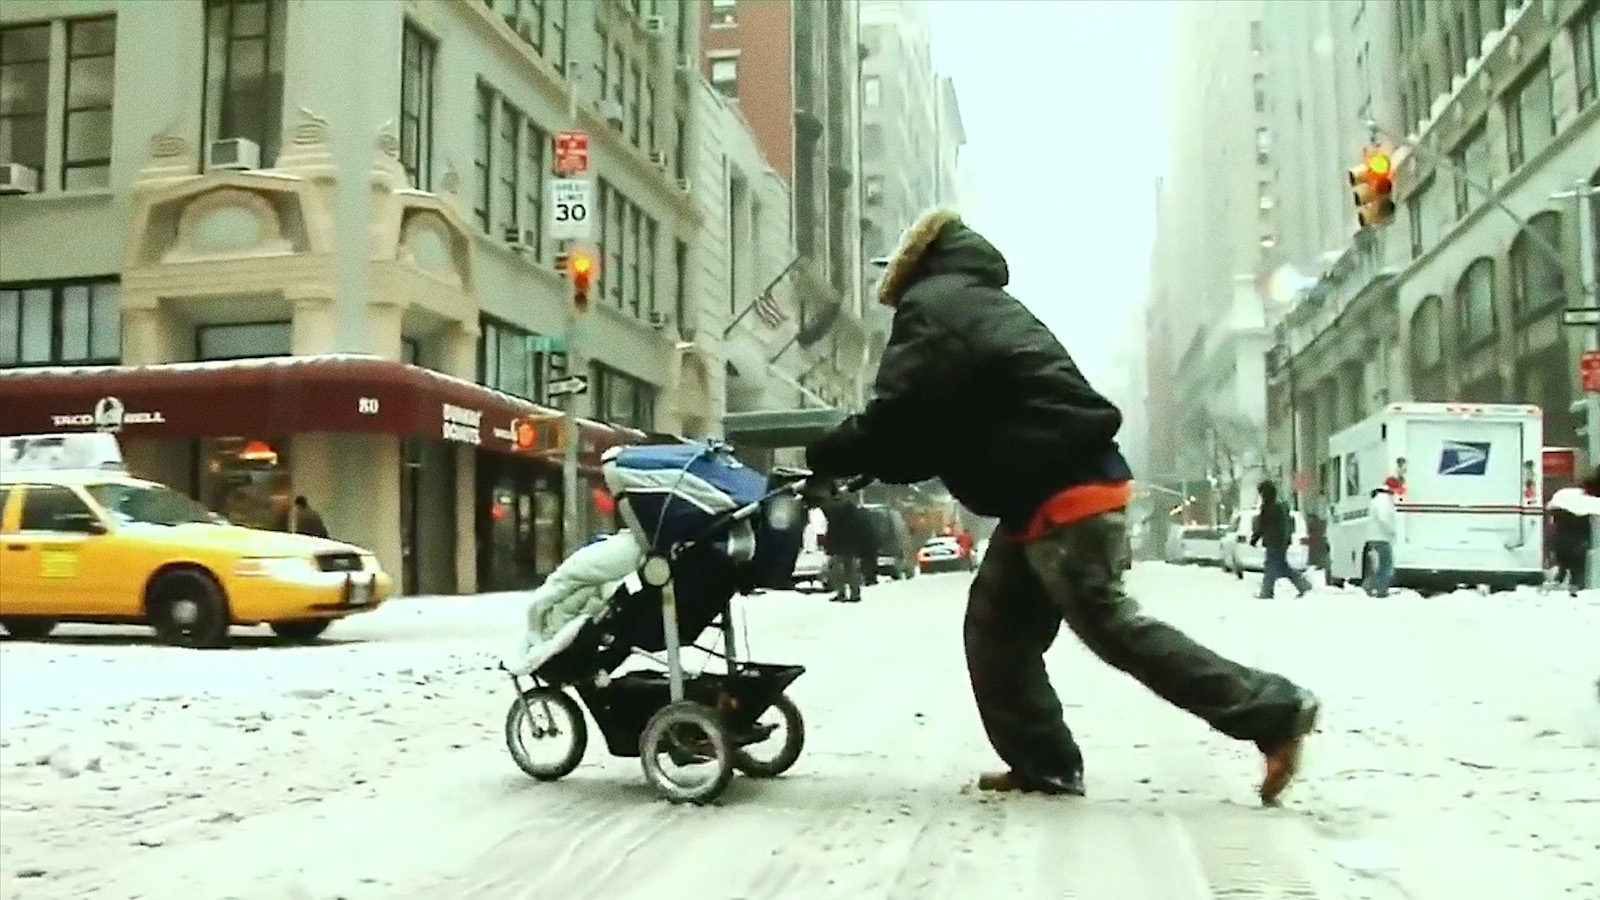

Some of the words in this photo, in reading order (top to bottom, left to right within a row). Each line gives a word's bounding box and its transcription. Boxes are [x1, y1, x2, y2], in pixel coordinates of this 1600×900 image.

[556, 204, 586, 222] 30
[358, 397, 379, 414] 80
[51, 414, 94, 426] TACO
